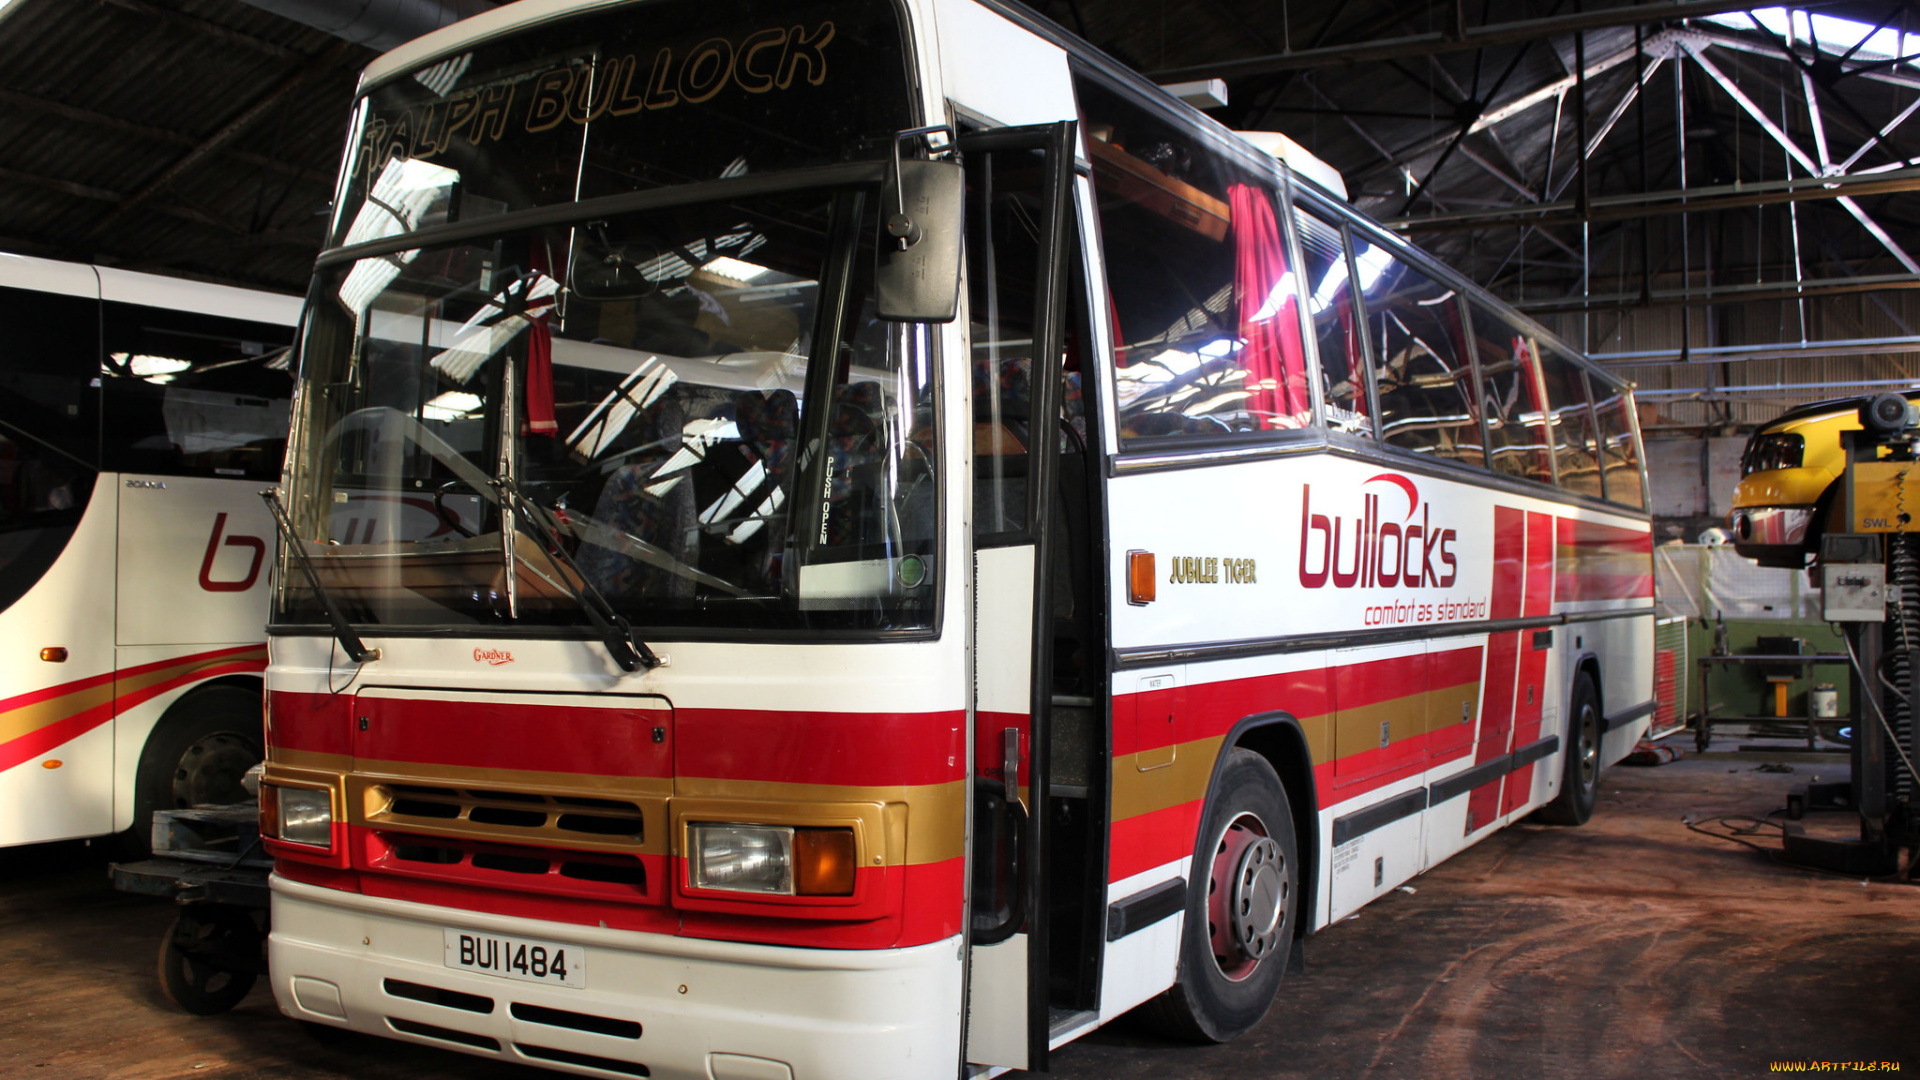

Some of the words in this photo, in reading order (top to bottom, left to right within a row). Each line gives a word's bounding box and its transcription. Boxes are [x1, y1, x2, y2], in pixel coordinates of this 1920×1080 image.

[353, 80, 516, 178] RALPH
[526, 21, 836, 133] BULLOCK
[823, 456, 834, 498] PUSH
[819, 501, 830, 545] OPEN
[1299, 483, 1457, 589] bullocks
[1862, 518, 1892, 529] SWL
[1169, 556, 1219, 584] JUBILEE
[1223, 557, 1258, 584] TIGER
[1364, 597, 1416, 626] comfort
[1417, 604, 1433, 622] as
[1437, 596, 1487, 621] standard
